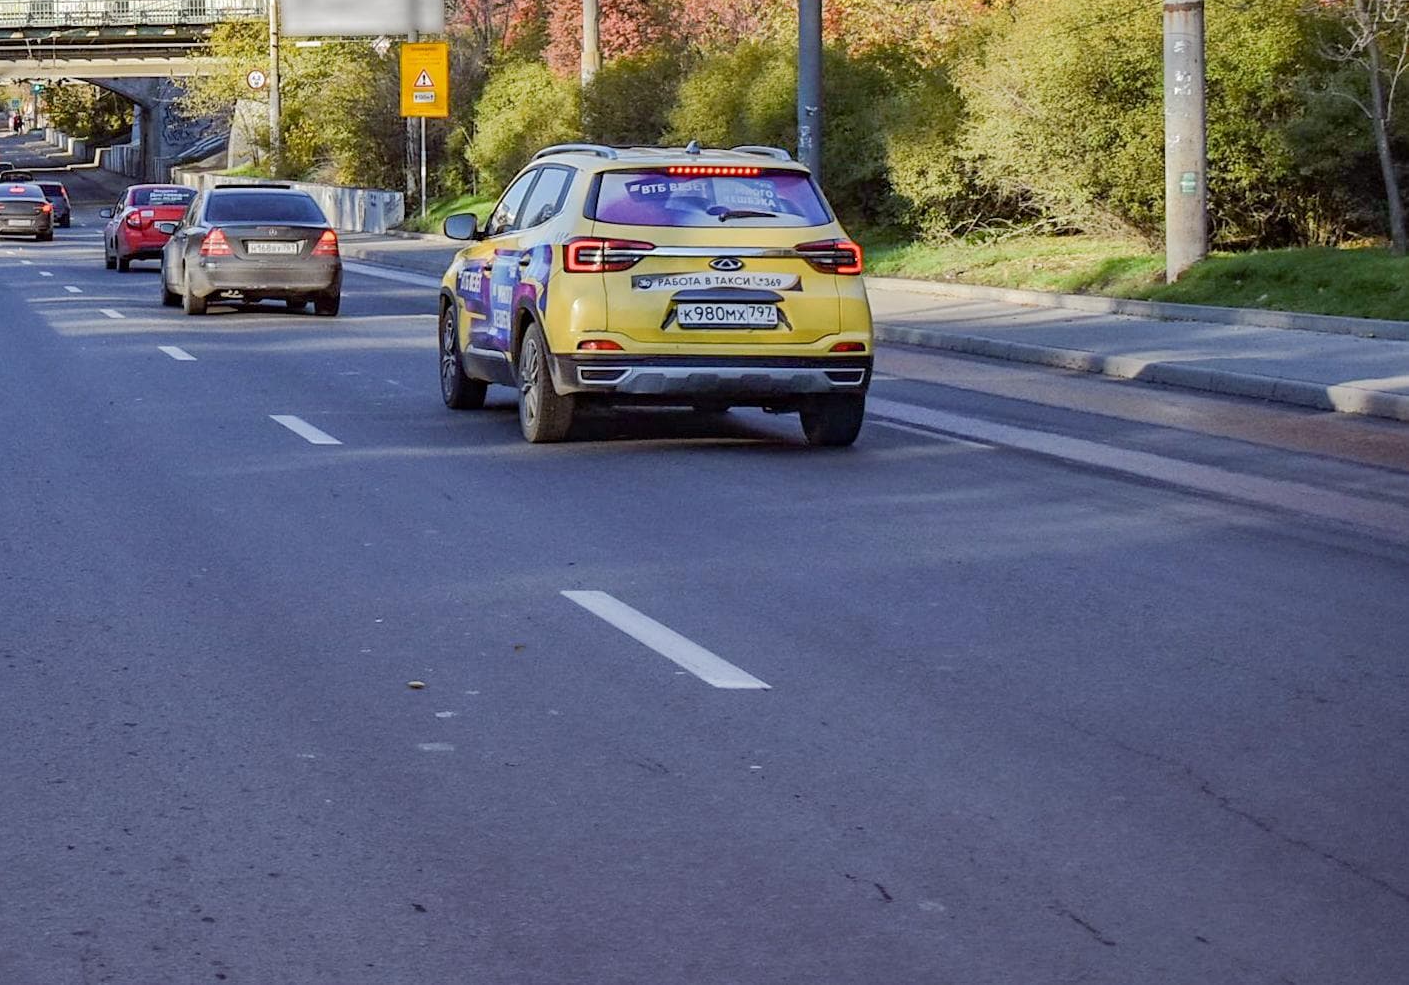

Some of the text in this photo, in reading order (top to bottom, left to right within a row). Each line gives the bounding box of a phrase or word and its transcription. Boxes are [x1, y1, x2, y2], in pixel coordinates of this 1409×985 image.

[641, 183, 666, 195] ВТБ
[658, 276, 701, 286] РАБОТА
[705, 276, 712, 285] В
[714, 276, 750, 285] ТАКСИ
